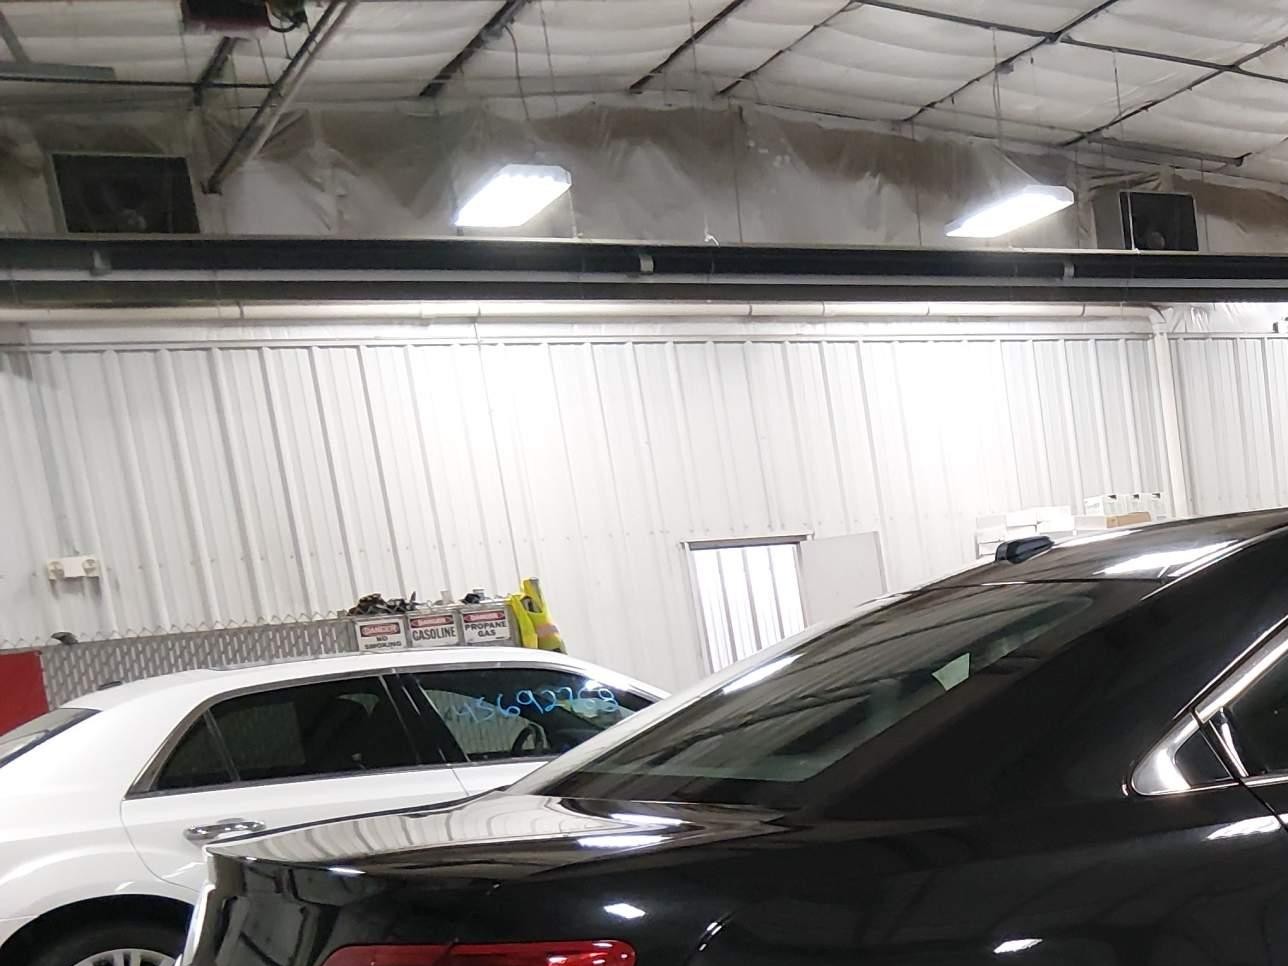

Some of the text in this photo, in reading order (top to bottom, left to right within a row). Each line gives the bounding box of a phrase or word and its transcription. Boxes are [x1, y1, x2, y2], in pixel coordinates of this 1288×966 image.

[464, 621, 507, 631] PROPANE
[412, 627, 457, 641] GASOLINE
[477, 629, 497, 637] GAS
